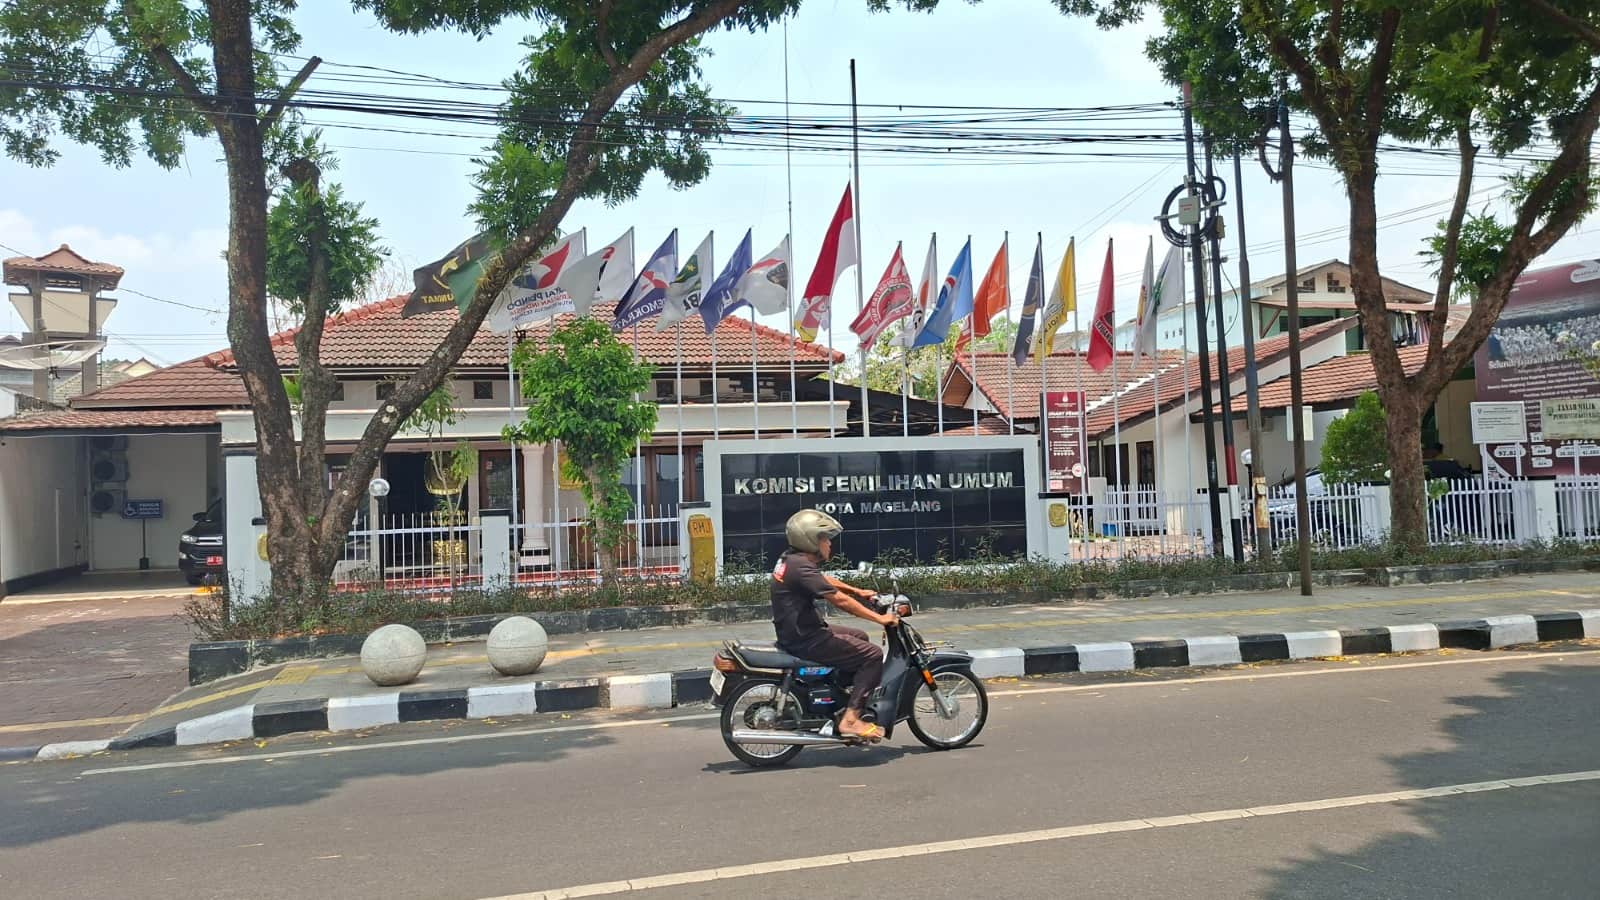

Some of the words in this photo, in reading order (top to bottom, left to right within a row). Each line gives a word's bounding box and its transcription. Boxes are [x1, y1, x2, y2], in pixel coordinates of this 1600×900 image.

[734, 477, 816, 495] KOMISI
[821, 473, 941, 492] PEMILIHAN
[948, 471, 1013, 489] UMUM
[815, 502, 854, 514] KOTA
[860, 500, 941, 513] MAGELANG
